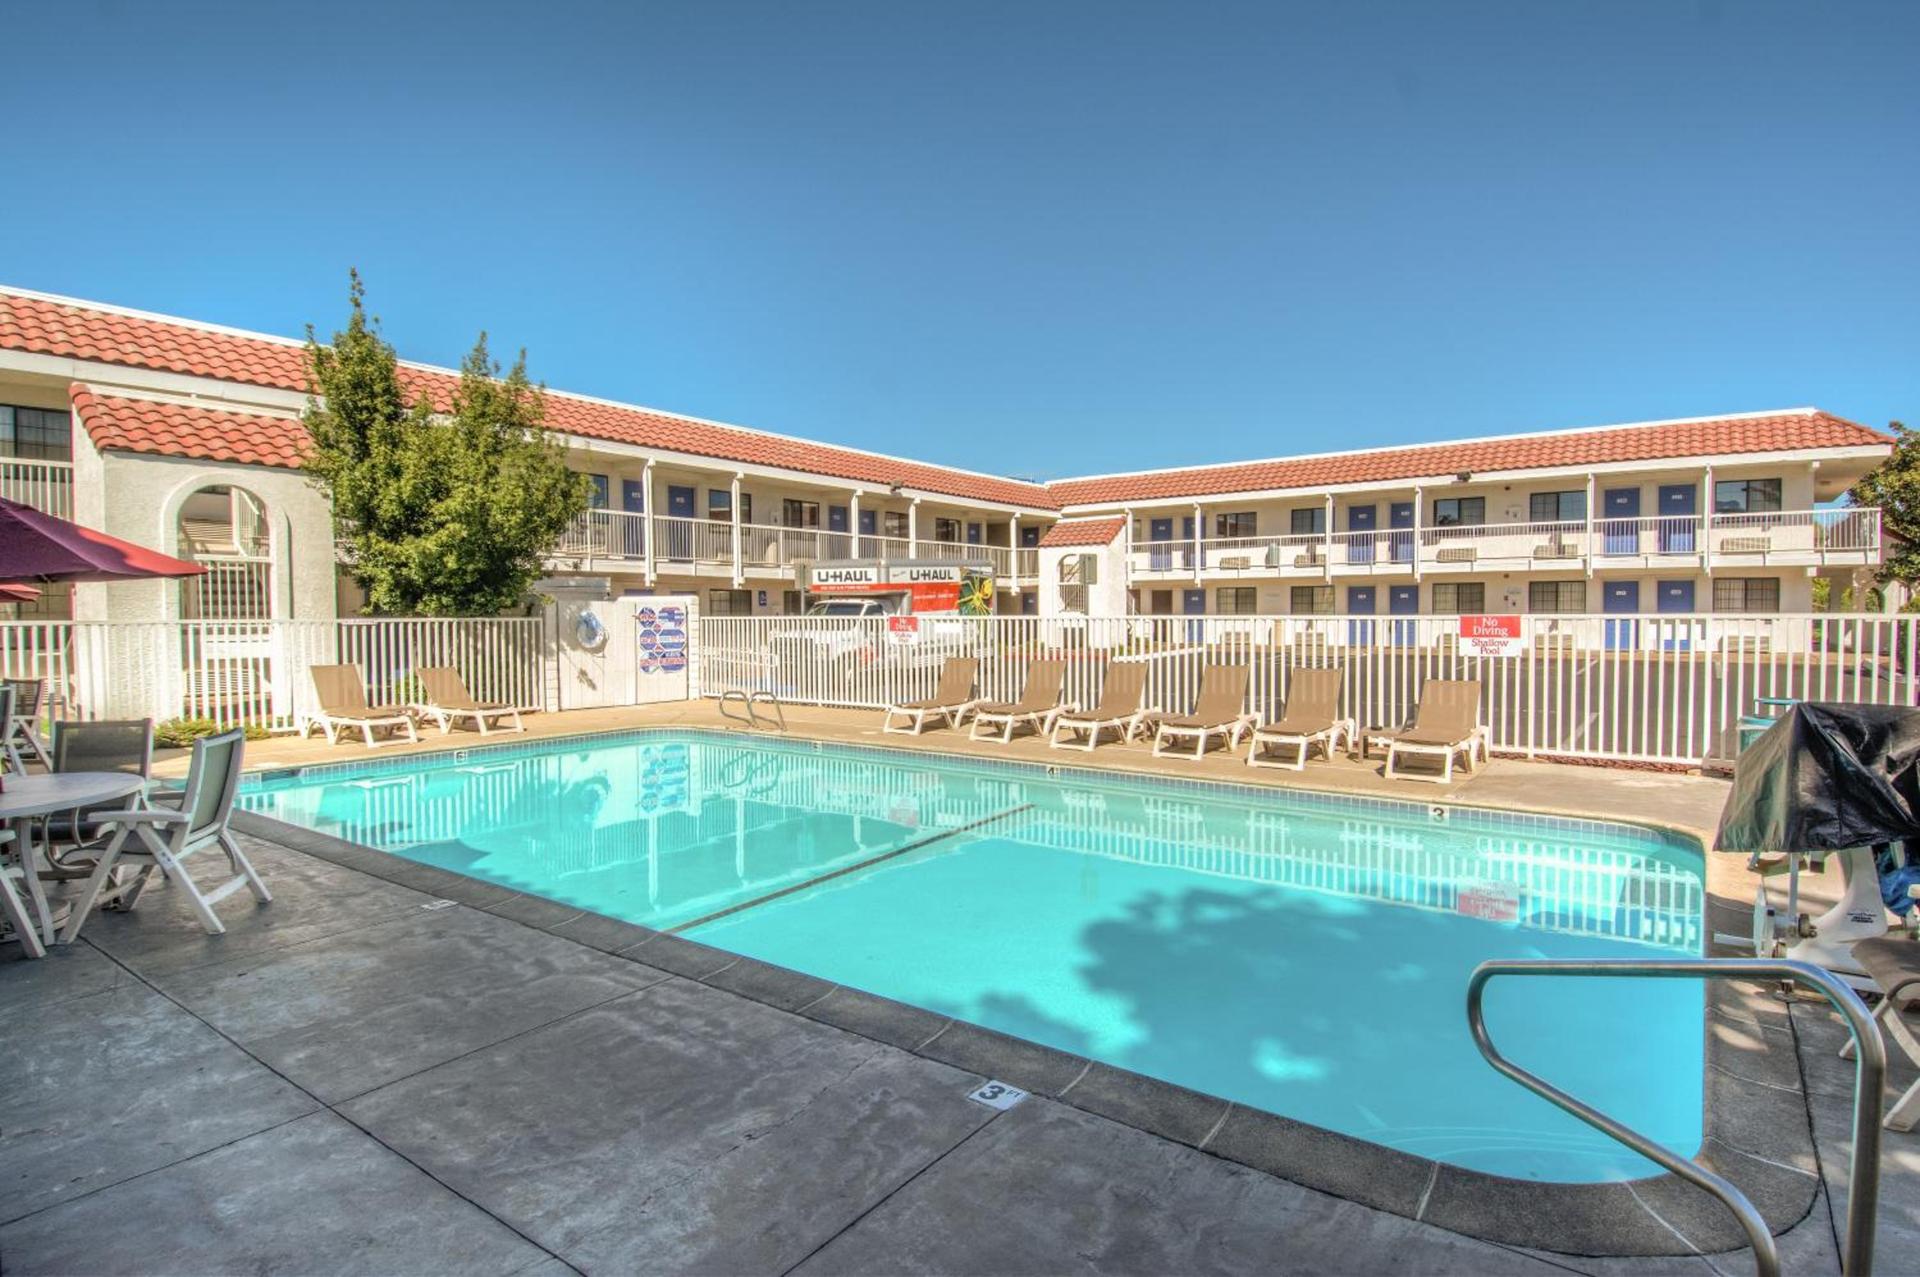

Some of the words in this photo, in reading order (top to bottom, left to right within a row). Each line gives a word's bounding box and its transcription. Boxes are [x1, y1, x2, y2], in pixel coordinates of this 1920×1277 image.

[817, 570, 873, 582] U-HAUL
[909, 569, 954, 581] U-HAUL
[1482, 617, 1498, 627] No
[1472, 627, 1509, 637] Diving
[1471, 638, 1509, 647] Shallow
[1480, 647, 1500, 655] Pool
[1433, 807, 1444, 822] 3
[978, 1085, 1005, 1100] 3
